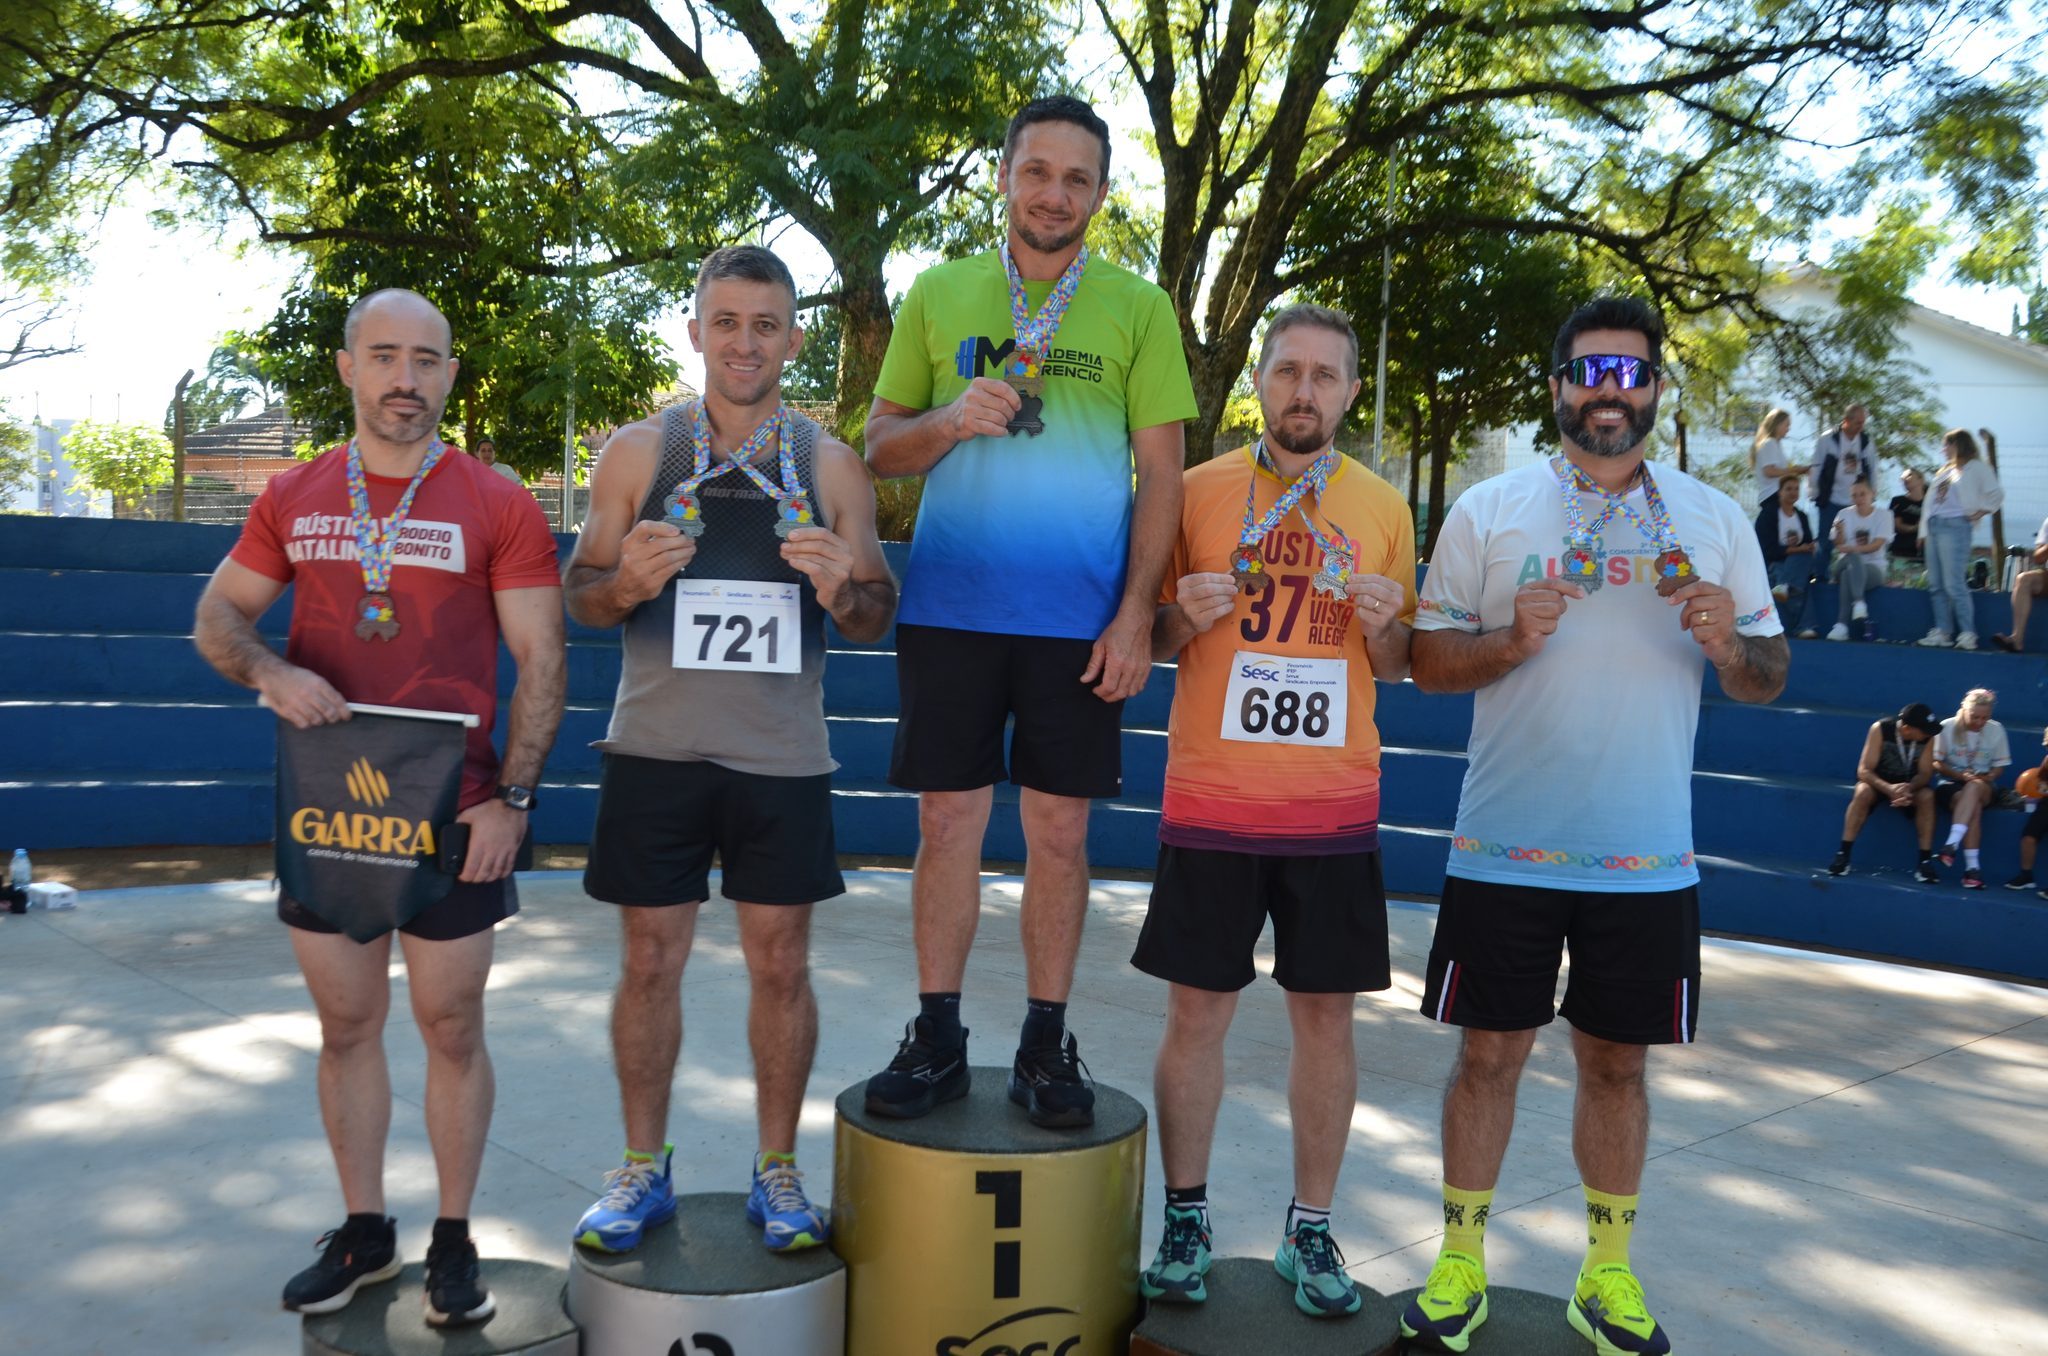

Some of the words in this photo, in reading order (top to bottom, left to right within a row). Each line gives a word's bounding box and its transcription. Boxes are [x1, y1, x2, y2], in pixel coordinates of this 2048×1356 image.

[1041, 364, 1103, 384] RENCIO
[1045, 348, 1104, 367] ADEMIA
[291, 511, 380, 540] RÚSTIA
[397, 526, 453, 544] RODEIO
[284, 539, 361, 564] NATALIN
[393, 541, 452, 561] BONITO
[1258, 523, 1362, 574] ÚSTA
[1240, 573, 1310, 644] 37
[1309, 600, 1355, 628] VISTA
[692, 613, 779, 664] 721
[1308, 625, 1347, 648] ALEGE
[1240, 686, 1331, 738] 688
[289, 807, 436, 856] GARRA
[306, 848, 342, 860] centro
[342, 851, 356, 861] de
[356, 853, 420, 869] treinamento
[975, 1170, 1022, 1298] 1
